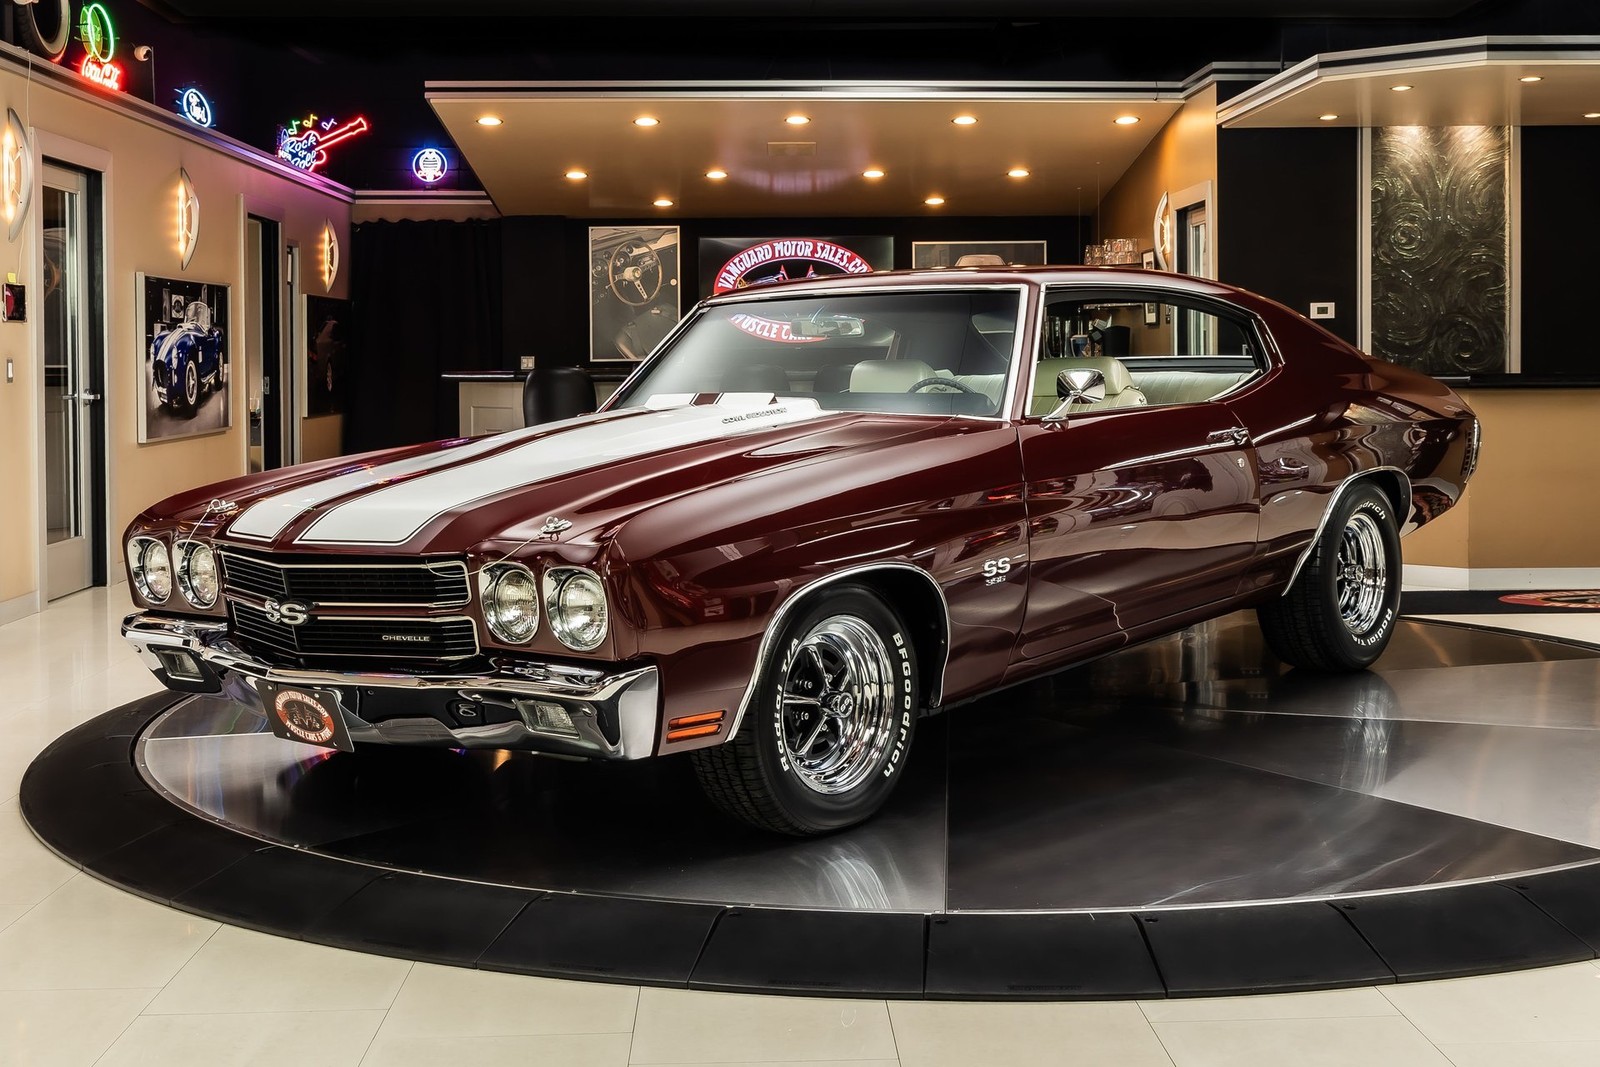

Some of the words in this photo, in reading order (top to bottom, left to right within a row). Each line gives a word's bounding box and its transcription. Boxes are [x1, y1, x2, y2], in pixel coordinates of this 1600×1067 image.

[288, 133, 316, 153] Rock
[718, 245, 773, 289] VANGUARD
[773, 241, 813, 257] MOTOR
[815, 242, 869, 273] SALES.CO
[731, 313, 780, 338] MUSCLE
[982, 557, 1011, 577] SS
[264, 600, 307, 625] SS
[1367, 608, 1392, 646] Radial
[774, 684, 790, 772] Radial
